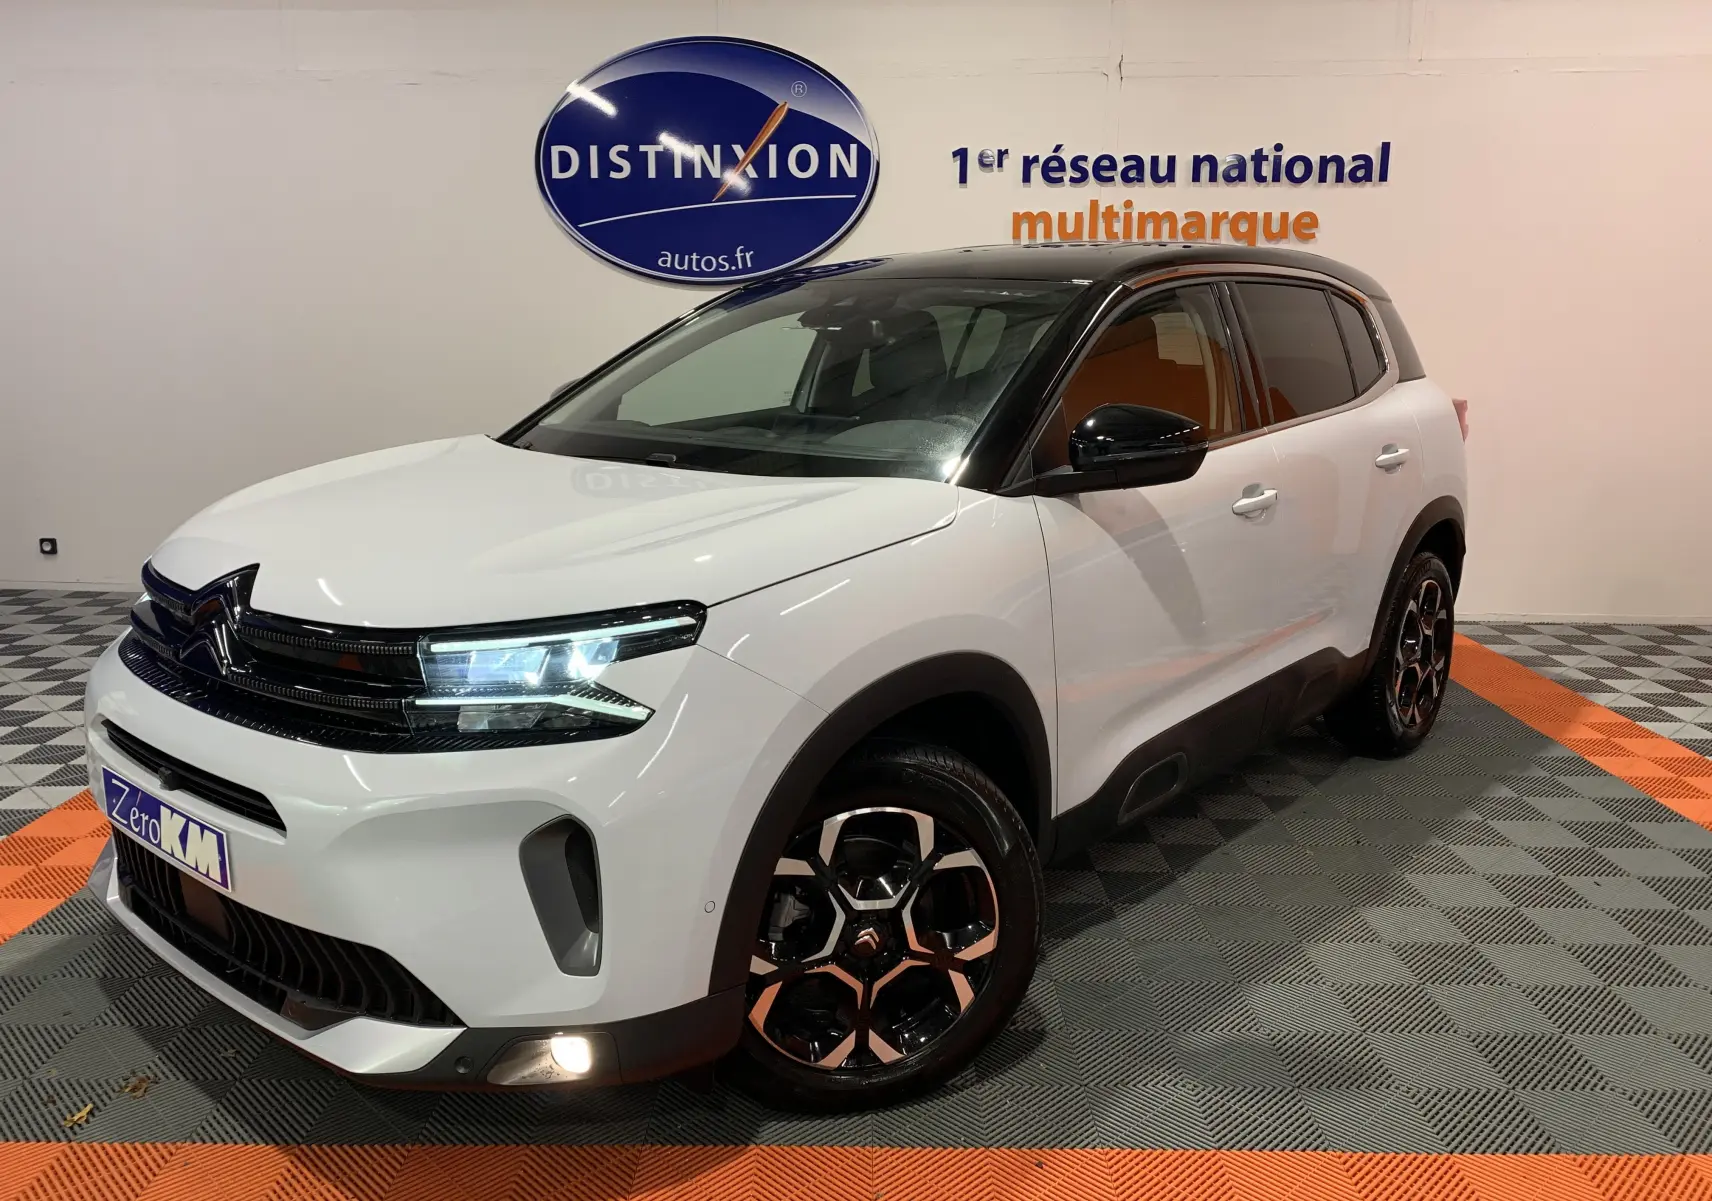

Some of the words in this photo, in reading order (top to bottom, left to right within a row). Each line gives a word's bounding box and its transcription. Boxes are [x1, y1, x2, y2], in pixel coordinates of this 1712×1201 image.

[549, 143, 858, 180] DISTINXION
[951, 146, 1010, 184] 1er
[1021, 144, 1177, 184] réseau
[1190, 141, 1391, 184] national
[1011, 199, 1319, 247] multimarque
[657, 246, 755, 273] autos.fr
